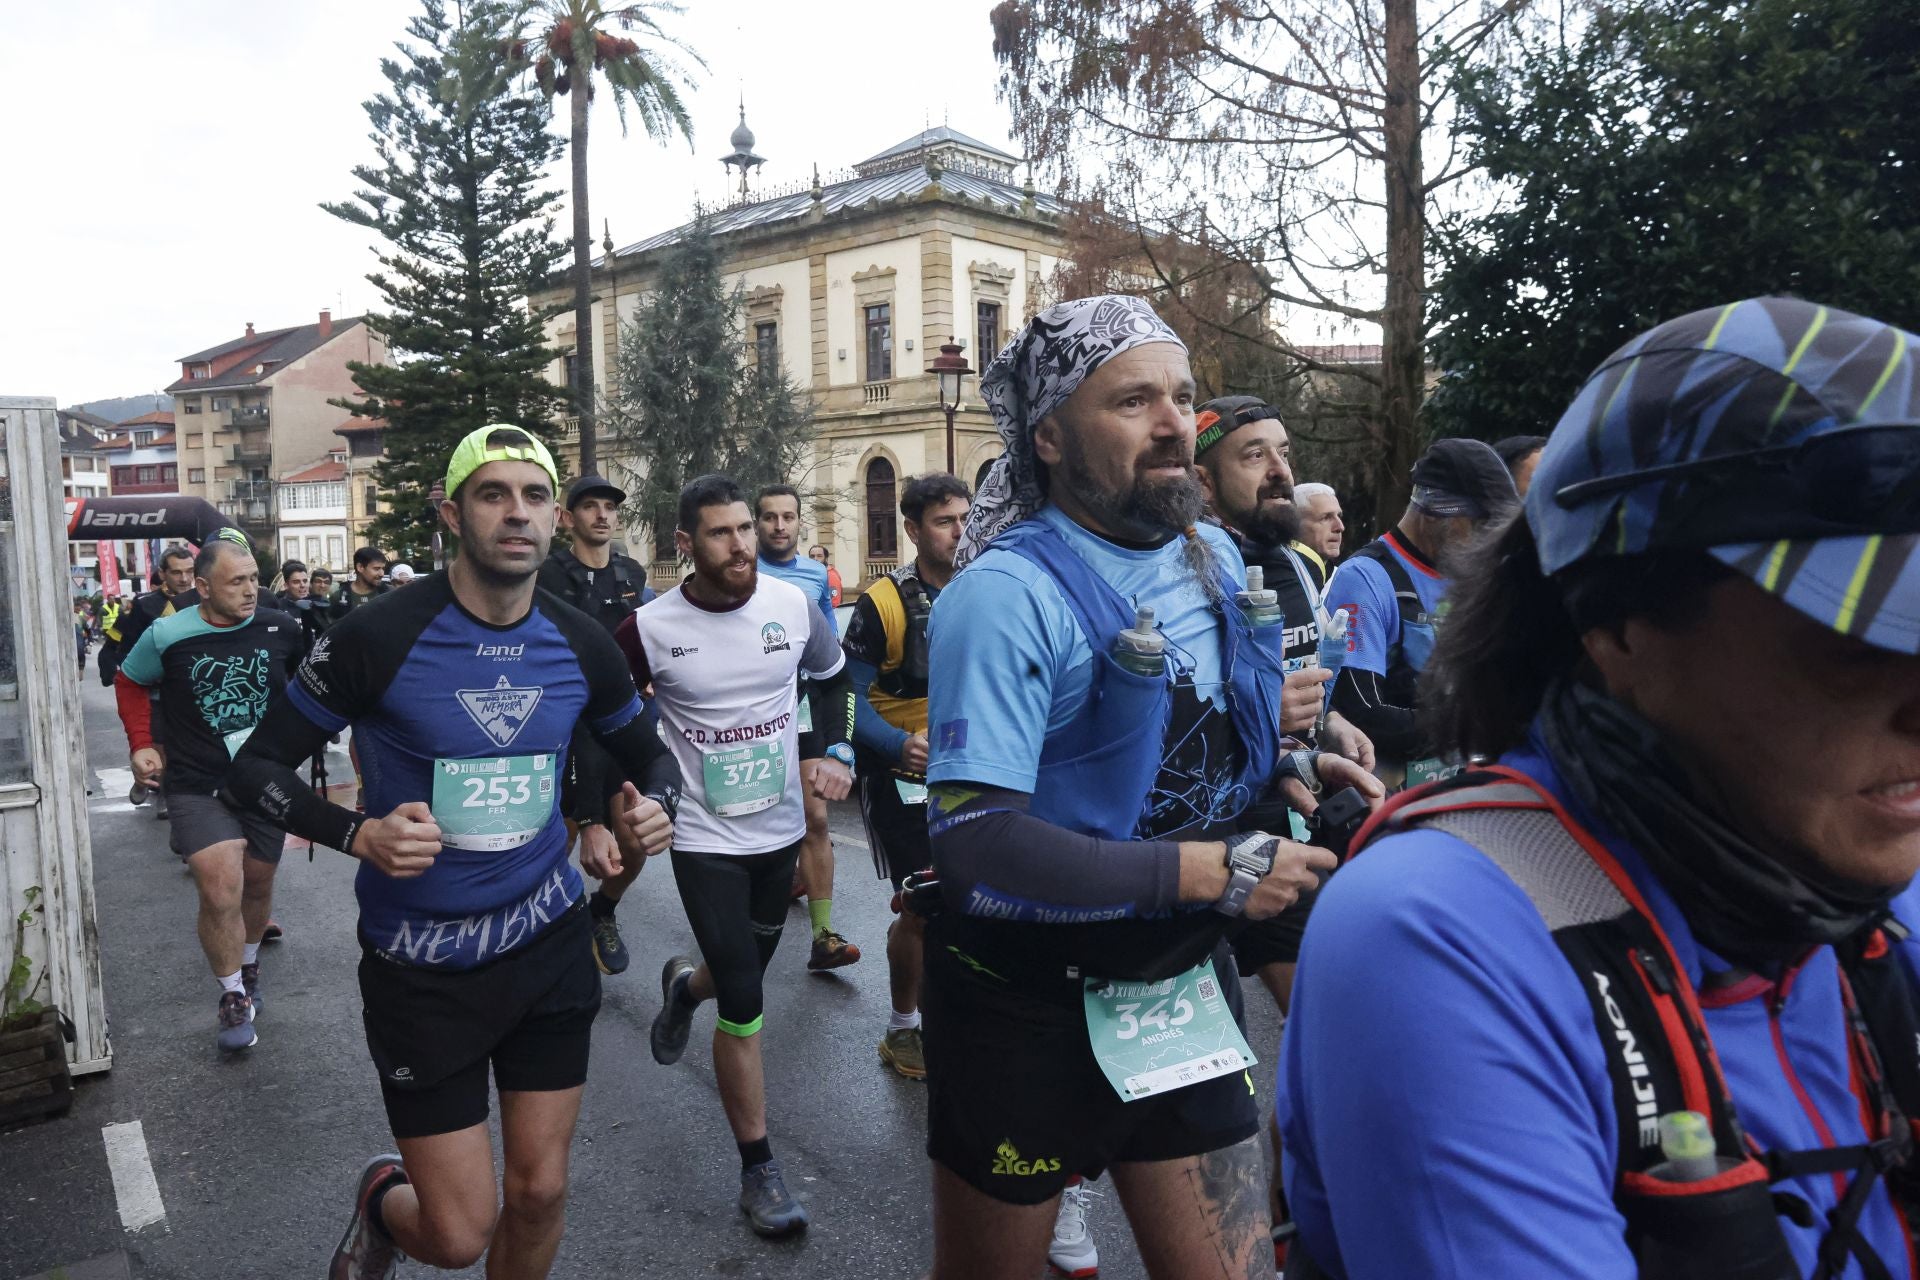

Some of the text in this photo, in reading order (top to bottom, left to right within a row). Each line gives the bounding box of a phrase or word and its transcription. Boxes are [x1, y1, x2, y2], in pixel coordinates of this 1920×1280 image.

[1197, 425, 1224, 449] TRAIL
[476, 643, 525, 657] land
[480, 700, 523, 714] NEMBRA
[683, 728, 710, 744] C.D.
[723, 758, 771, 786] 372
[462, 775, 531, 808] 253
[739, 781, 760, 789] DAVID
[488, 807, 507, 815] FER
[968, 890, 1022, 920] TRAIL
[387, 866, 574, 964] NEMBRA
[1035, 907, 1126, 923] DESNIVAL
[1141, 1028, 1185, 1046] ANDRÉS
[1592, 970, 1659, 1148] AONIJIE
[992, 1154, 1061, 1175] ZIGAS
